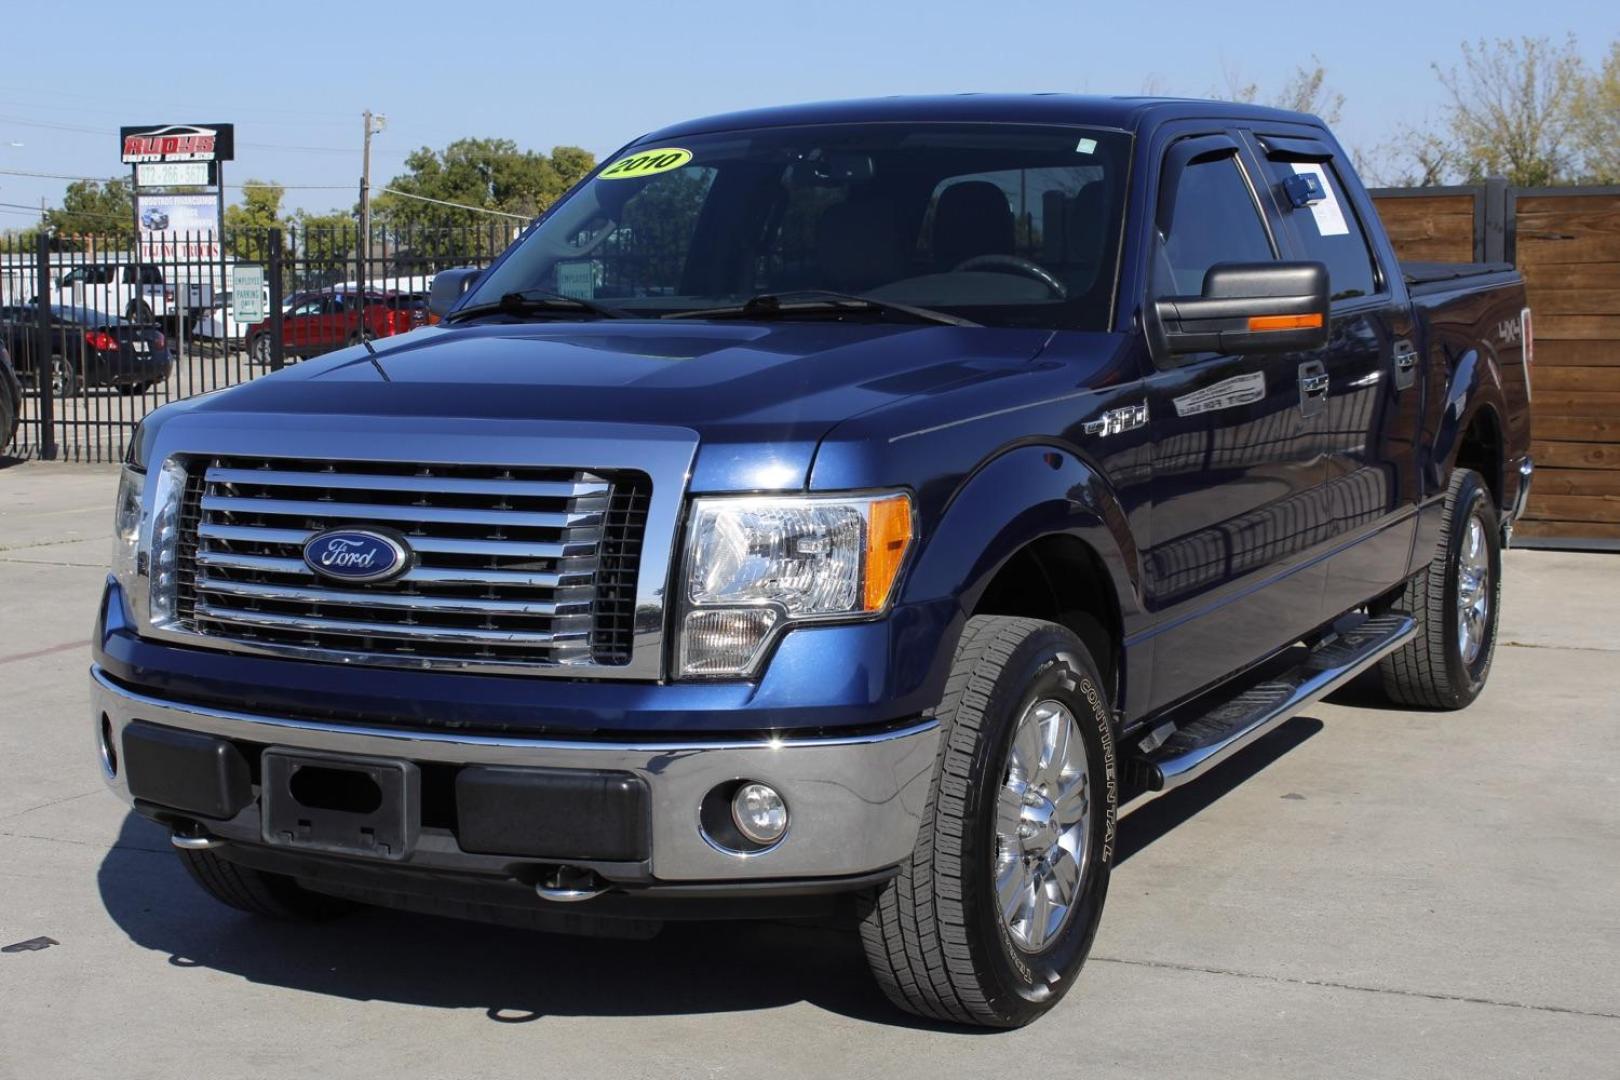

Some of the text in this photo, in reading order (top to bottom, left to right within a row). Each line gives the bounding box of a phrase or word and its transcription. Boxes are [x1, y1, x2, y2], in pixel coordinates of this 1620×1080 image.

[604, 153, 682, 175] 2010
[237, 290, 260, 299] PARKING
[321, 538, 377, 568] Ford
[1080, 679, 1116, 862] CONTINENTAL
